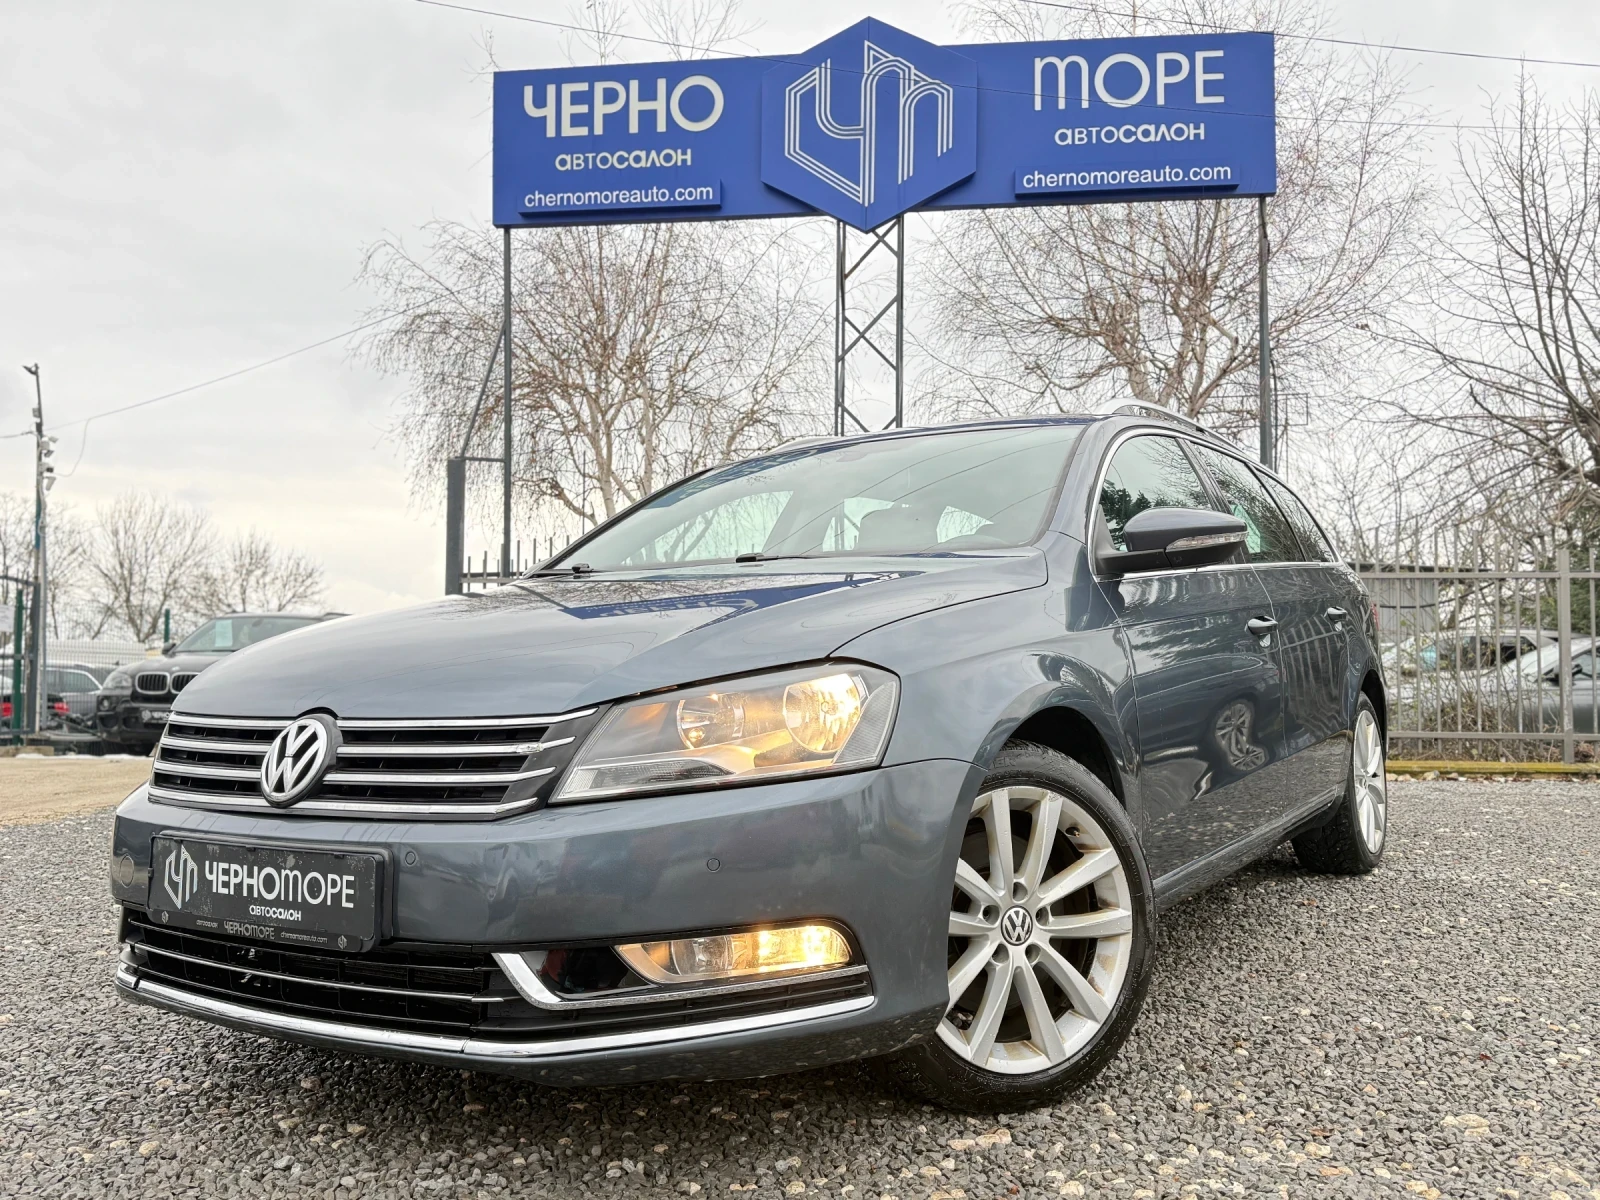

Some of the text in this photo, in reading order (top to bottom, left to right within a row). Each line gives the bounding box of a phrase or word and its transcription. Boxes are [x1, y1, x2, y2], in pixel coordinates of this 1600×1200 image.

[1034, 50, 1225, 111] МОРЕ
[523, 75, 724, 138] ЧЕРНО
[1054, 122, 1205, 146] автосалон
[555, 148, 692, 171] автосалон
[1023, 165, 1232, 188] chernomoreauto.com
[524, 186, 713, 207] chernomoreauto.com
[205, 860, 355, 908] ЧЕРНОМОРЕ
[249, 904, 302, 922] автосалон
